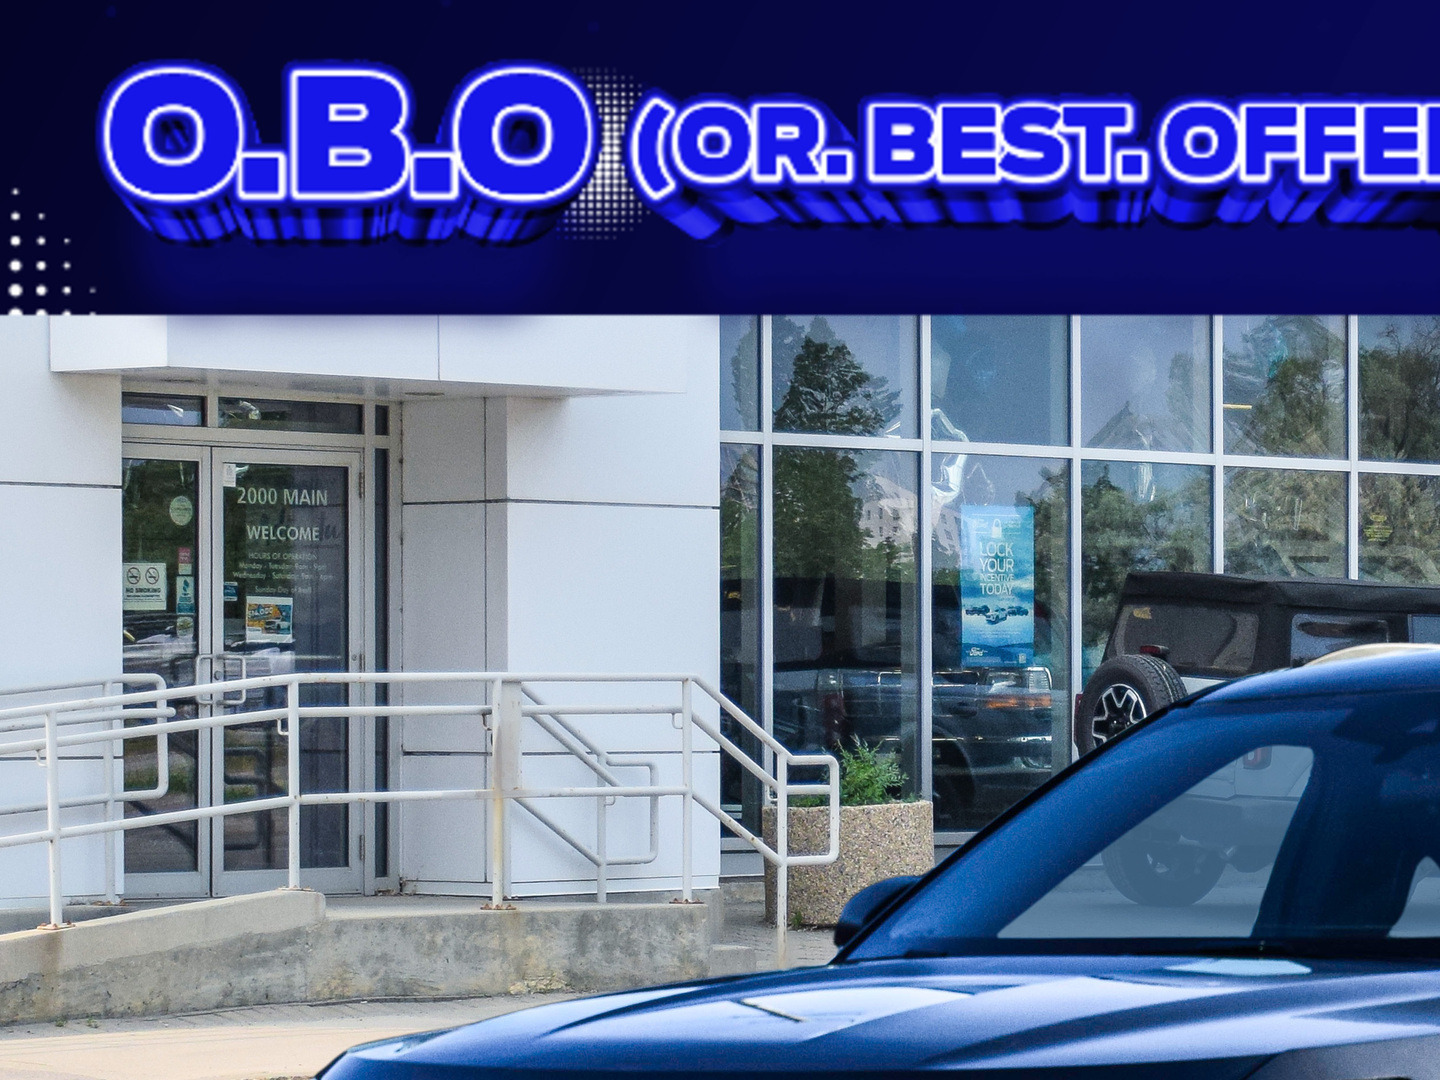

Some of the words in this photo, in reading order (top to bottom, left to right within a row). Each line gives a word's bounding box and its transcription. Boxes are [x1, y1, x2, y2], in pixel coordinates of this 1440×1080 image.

[236, 487, 278, 505] 2000
[283, 488, 328, 506] MAIN
[246, 524, 320, 541] WELCOME
[979, 542, 1014, 557] LOCK
[979, 558, 1015, 573] YOUR
[980, 583, 1014, 595] TODAY
